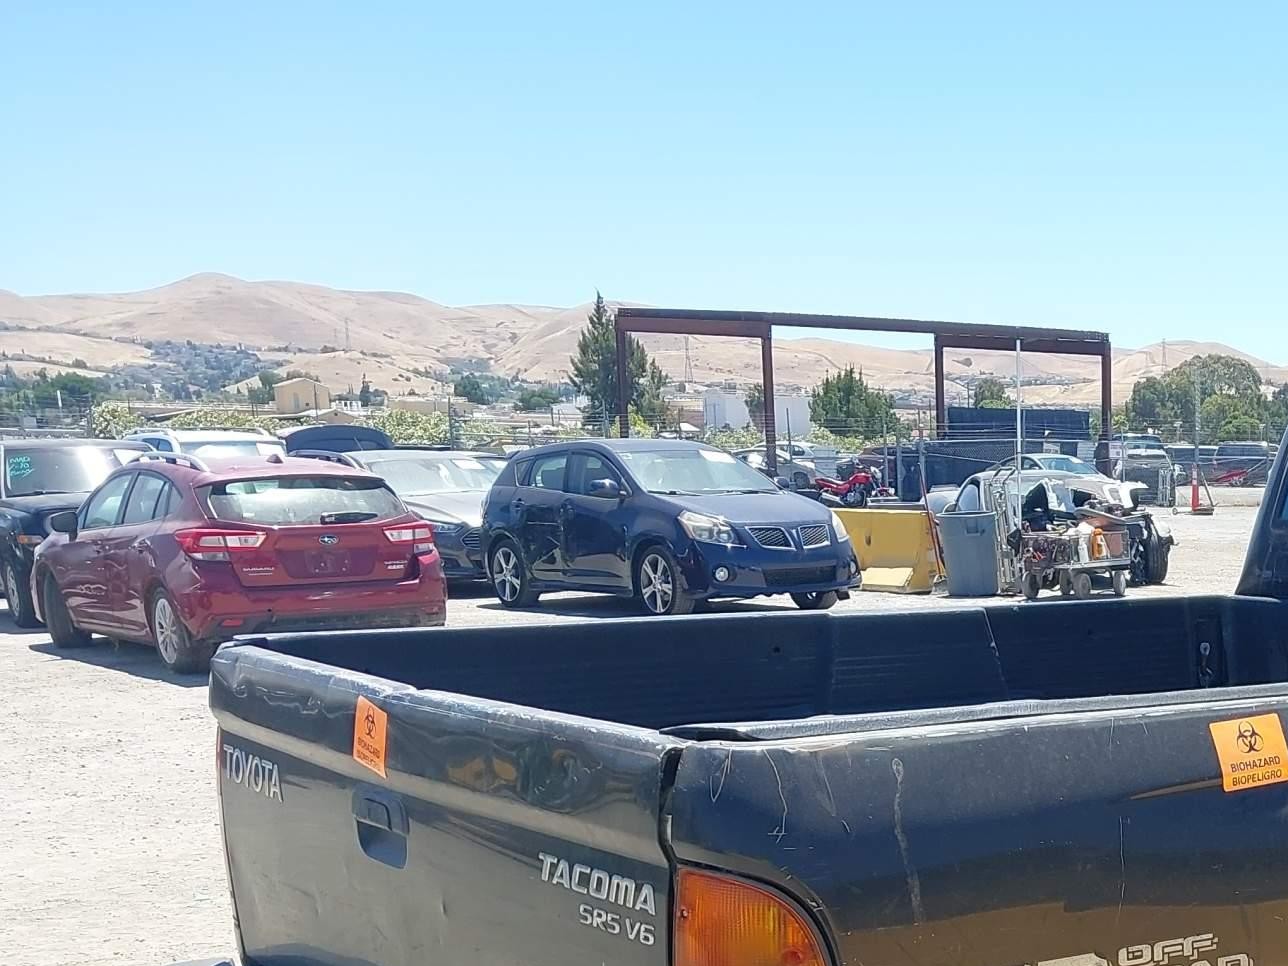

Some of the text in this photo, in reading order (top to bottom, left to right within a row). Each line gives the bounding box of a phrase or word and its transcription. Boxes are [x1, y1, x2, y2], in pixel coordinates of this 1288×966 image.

[223, 743, 284, 803] TOYOTA
[1230, 755, 1281, 773] BIOHAZARD
[1232, 768, 1283, 787] BIOPELIGRO
[538, 852, 656, 916] TACOMA
[579, 903, 655, 946] SR5 V6
